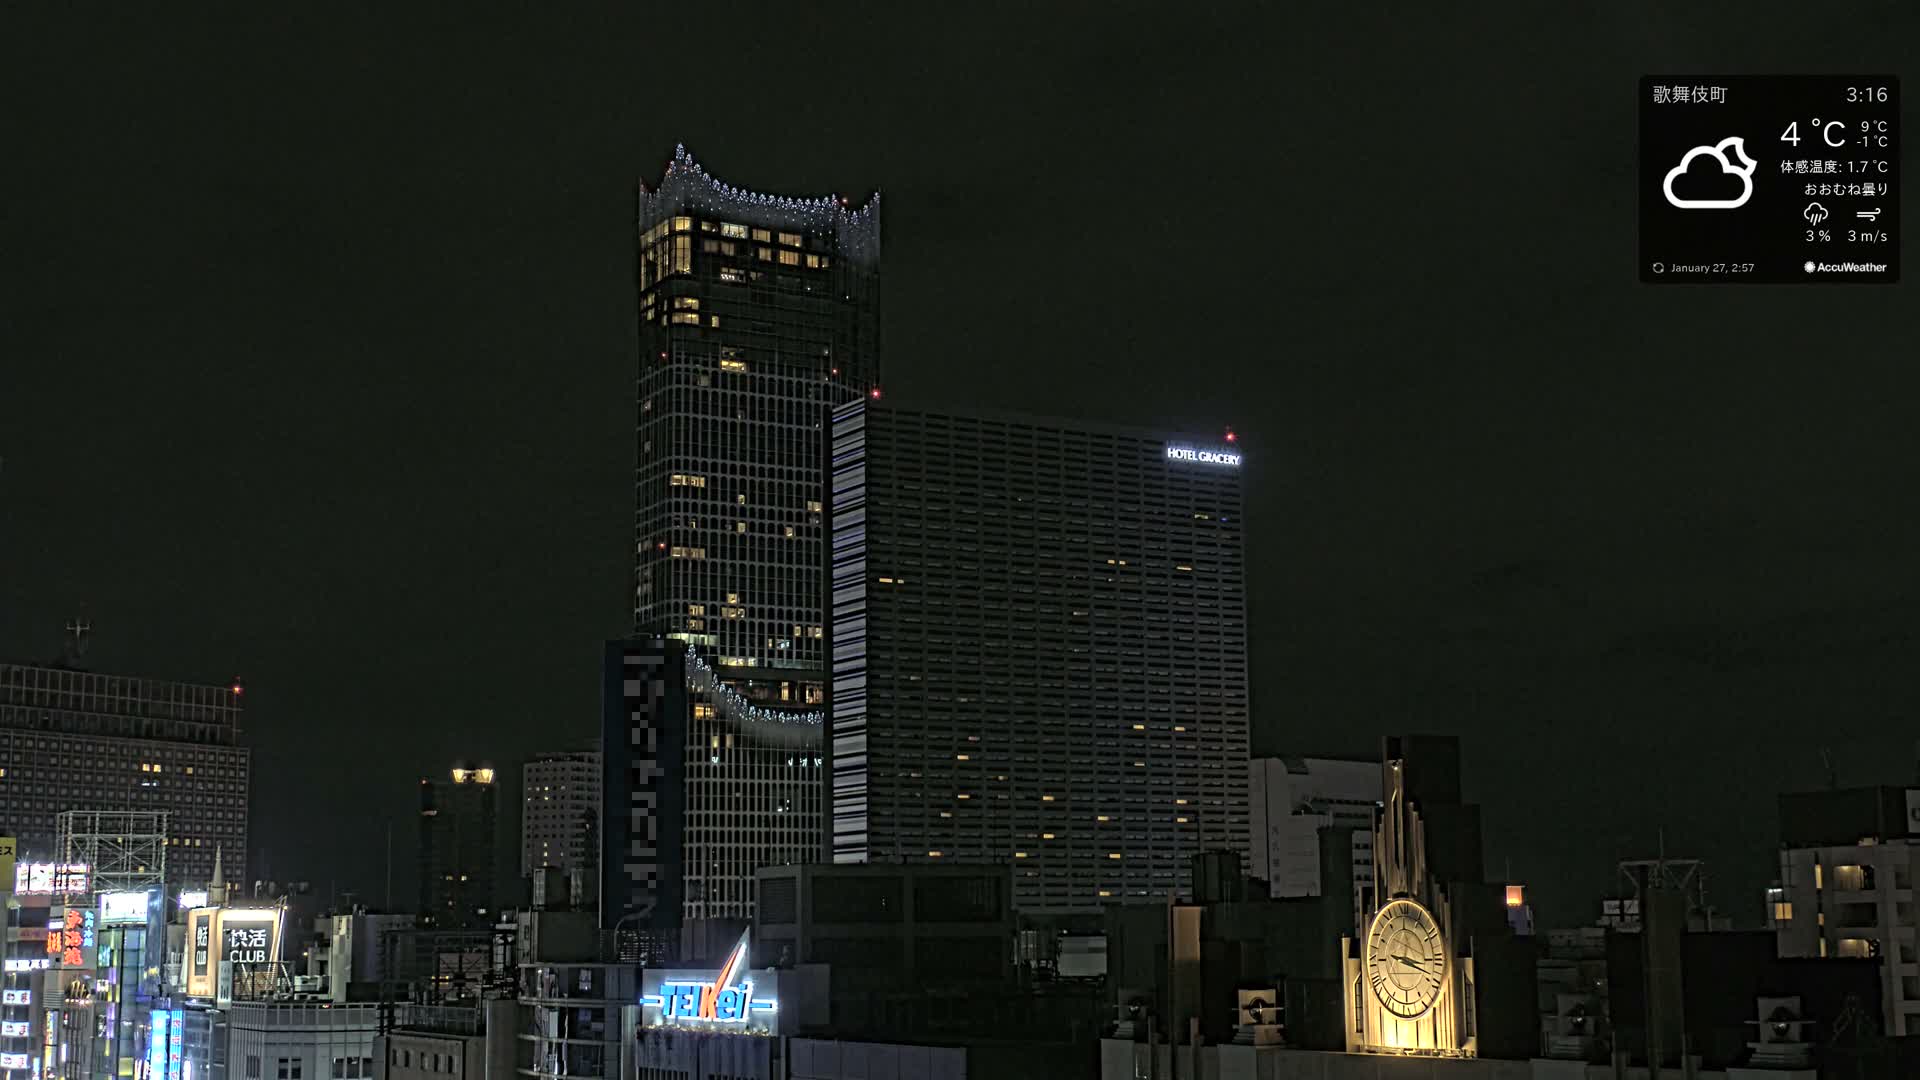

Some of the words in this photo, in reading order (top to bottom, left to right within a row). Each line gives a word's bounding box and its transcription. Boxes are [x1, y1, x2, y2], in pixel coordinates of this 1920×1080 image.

[1167, 447, 1198, 461] HOTEL
[1198, 451, 1240, 465] GRACERY
[229, 929, 266, 947] 快活
[230, 950, 265, 963] CLUB
